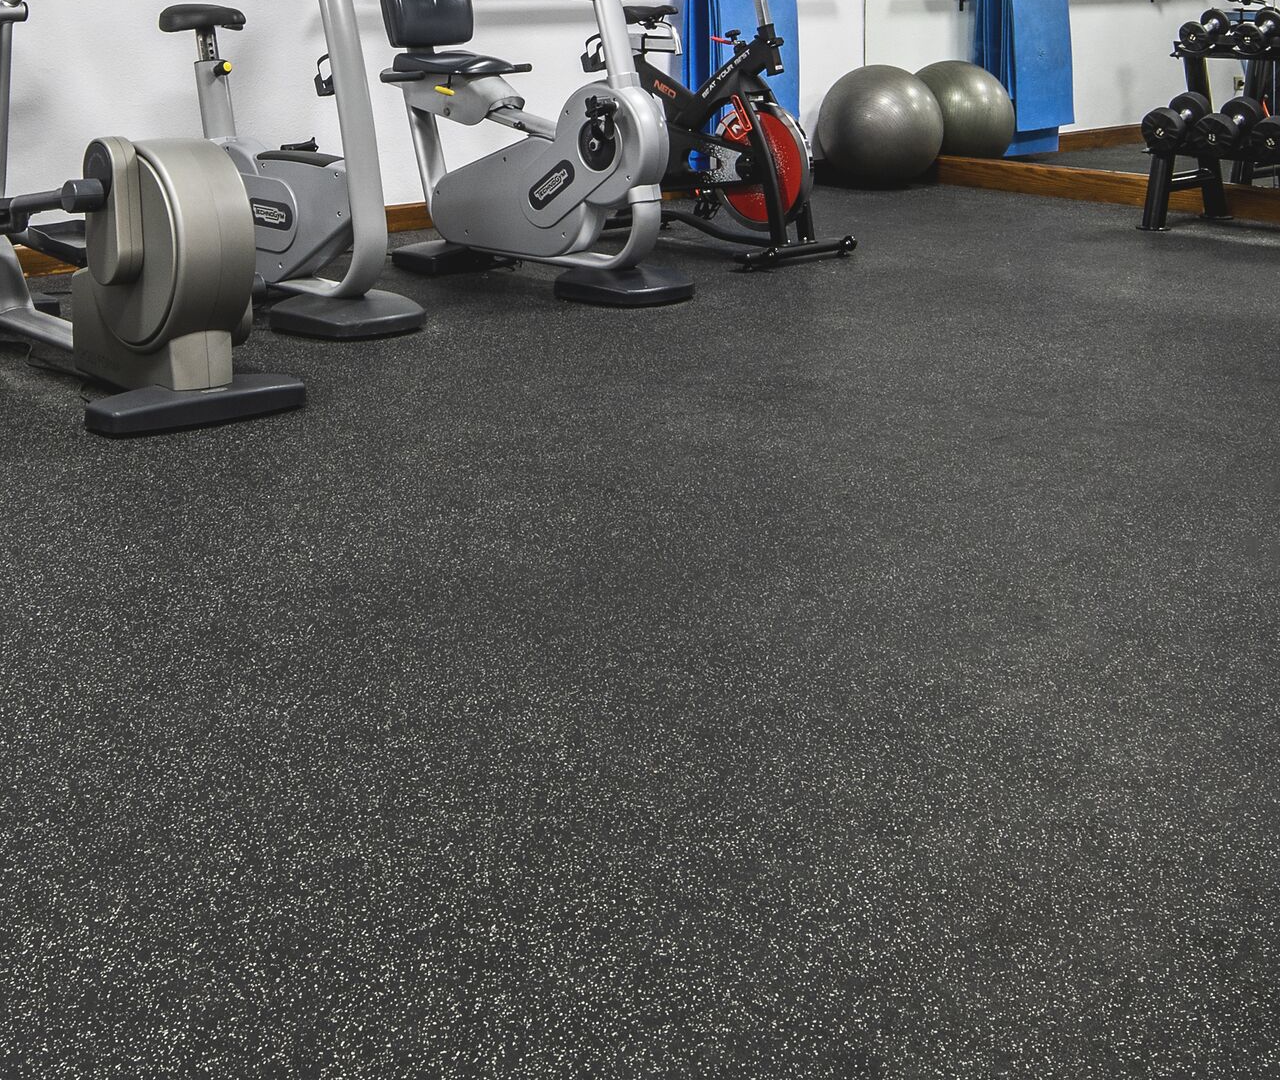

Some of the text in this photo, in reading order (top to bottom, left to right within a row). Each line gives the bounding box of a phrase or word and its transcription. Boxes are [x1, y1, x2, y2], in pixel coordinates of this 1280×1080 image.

[653, 79, 677, 99] NEO
[702, 80, 717, 99] BEAT
[716, 64, 734, 81] YOUR
